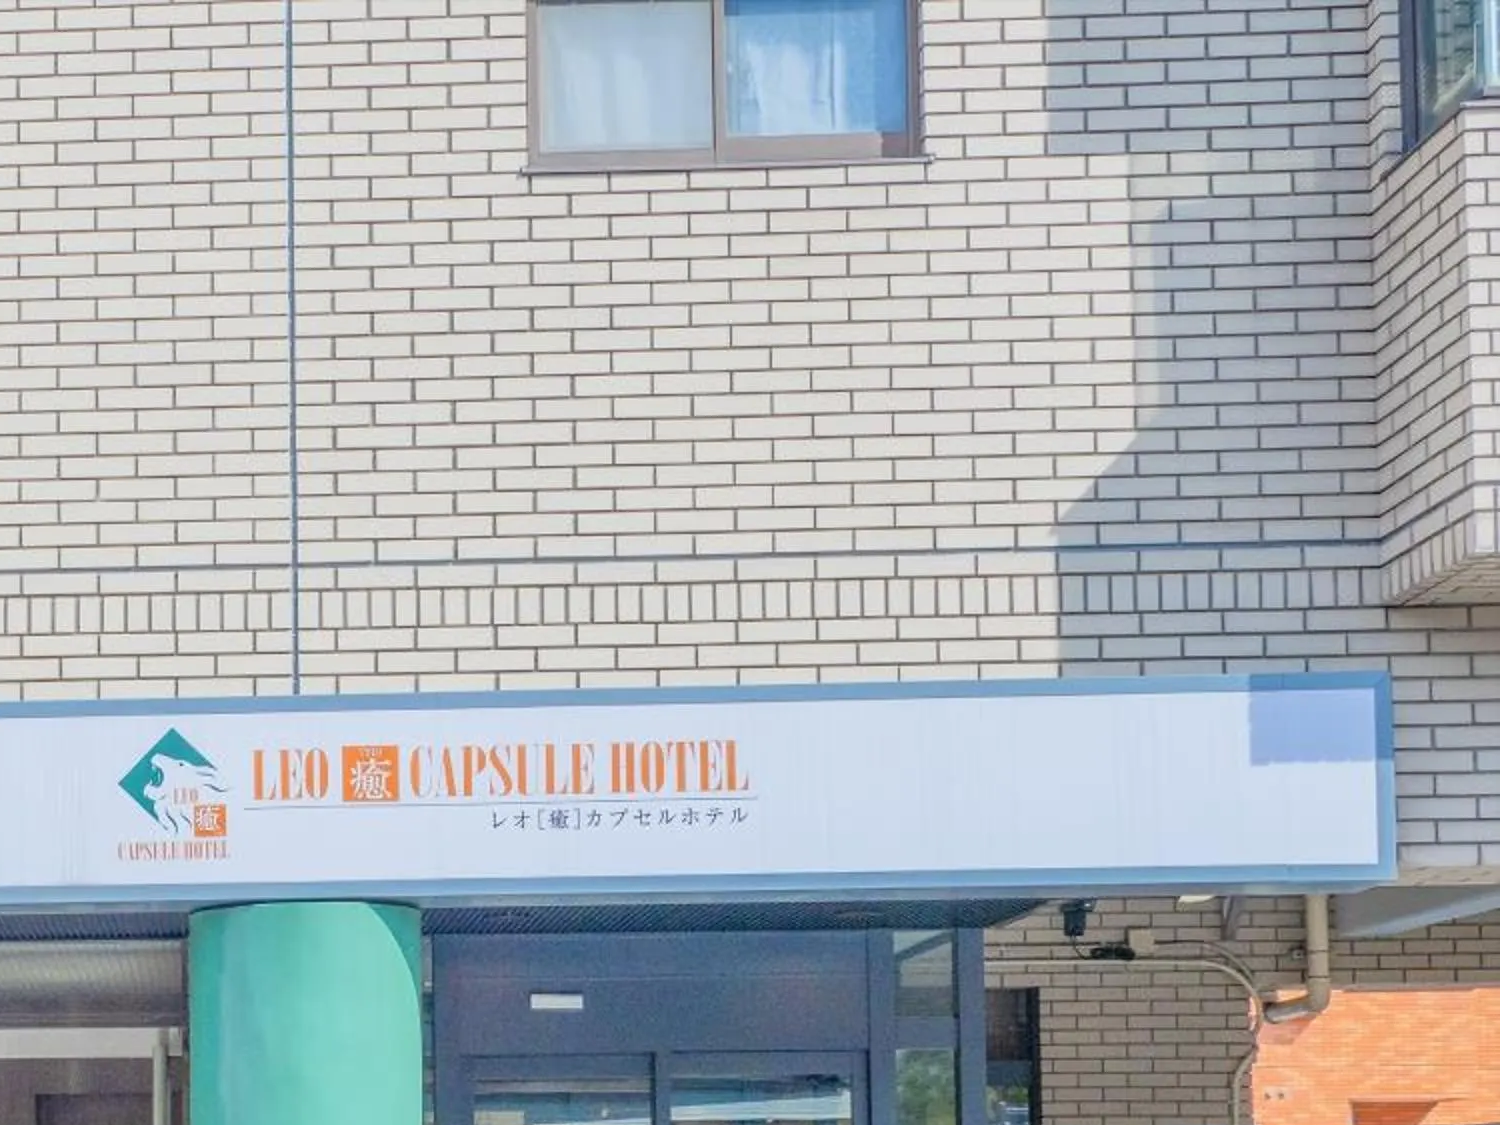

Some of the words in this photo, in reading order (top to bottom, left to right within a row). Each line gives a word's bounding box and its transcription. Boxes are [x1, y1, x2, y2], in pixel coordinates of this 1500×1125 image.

[253, 748, 328, 801] LEO
[409, 743, 594, 798] CAPSULE
[609, 740, 749, 793] HOTEL
